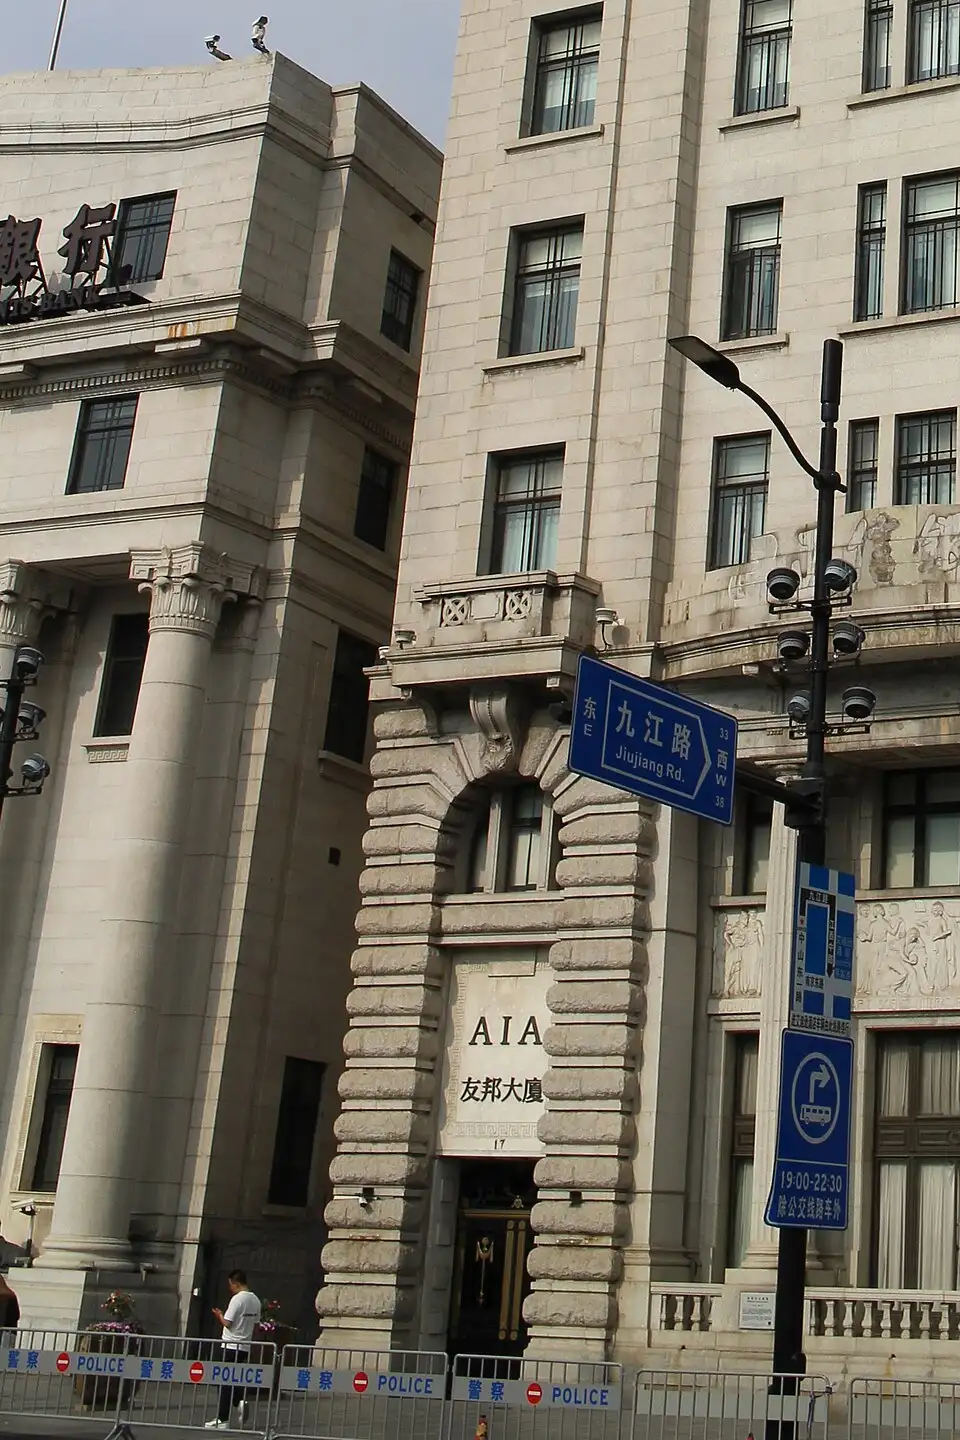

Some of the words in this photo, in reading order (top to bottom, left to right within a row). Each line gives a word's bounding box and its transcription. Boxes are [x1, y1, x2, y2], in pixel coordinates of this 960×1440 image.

[583, 696, 597, 720] 东
[583, 724, 593, 737] E
[615, 700, 692, 760] 九江路
[719, 727, 729, 740] 33
[616, 745, 663, 778] Jiujiang
[666, 763, 685, 783] Rd.
[717, 748, 729, 771] 西
[715, 773, 727, 787] W
[714, 795, 725, 808] 38
[808, 891, 828, 904] 九江路
[468, 1016, 543, 1045] AIA
[494, 1139, 505, 1150] 17
[781, 1171, 842, 1193] 19:00-22:30
[777, 1194, 841, 1221] 除公交线路车外
[8, 1350, 39, 1369] 警察
[77, 1356, 125, 1373] POLICE
[140, 1360, 174, 1379] 警察
[212, 1366, 263, 1384] POLICE
[297, 1369, 333, 1391] 警察
[377, 1375, 433, 1394] POLICE
[468, 1379, 504, 1401] 警察
[552, 1387, 609, 1406] POLICE
